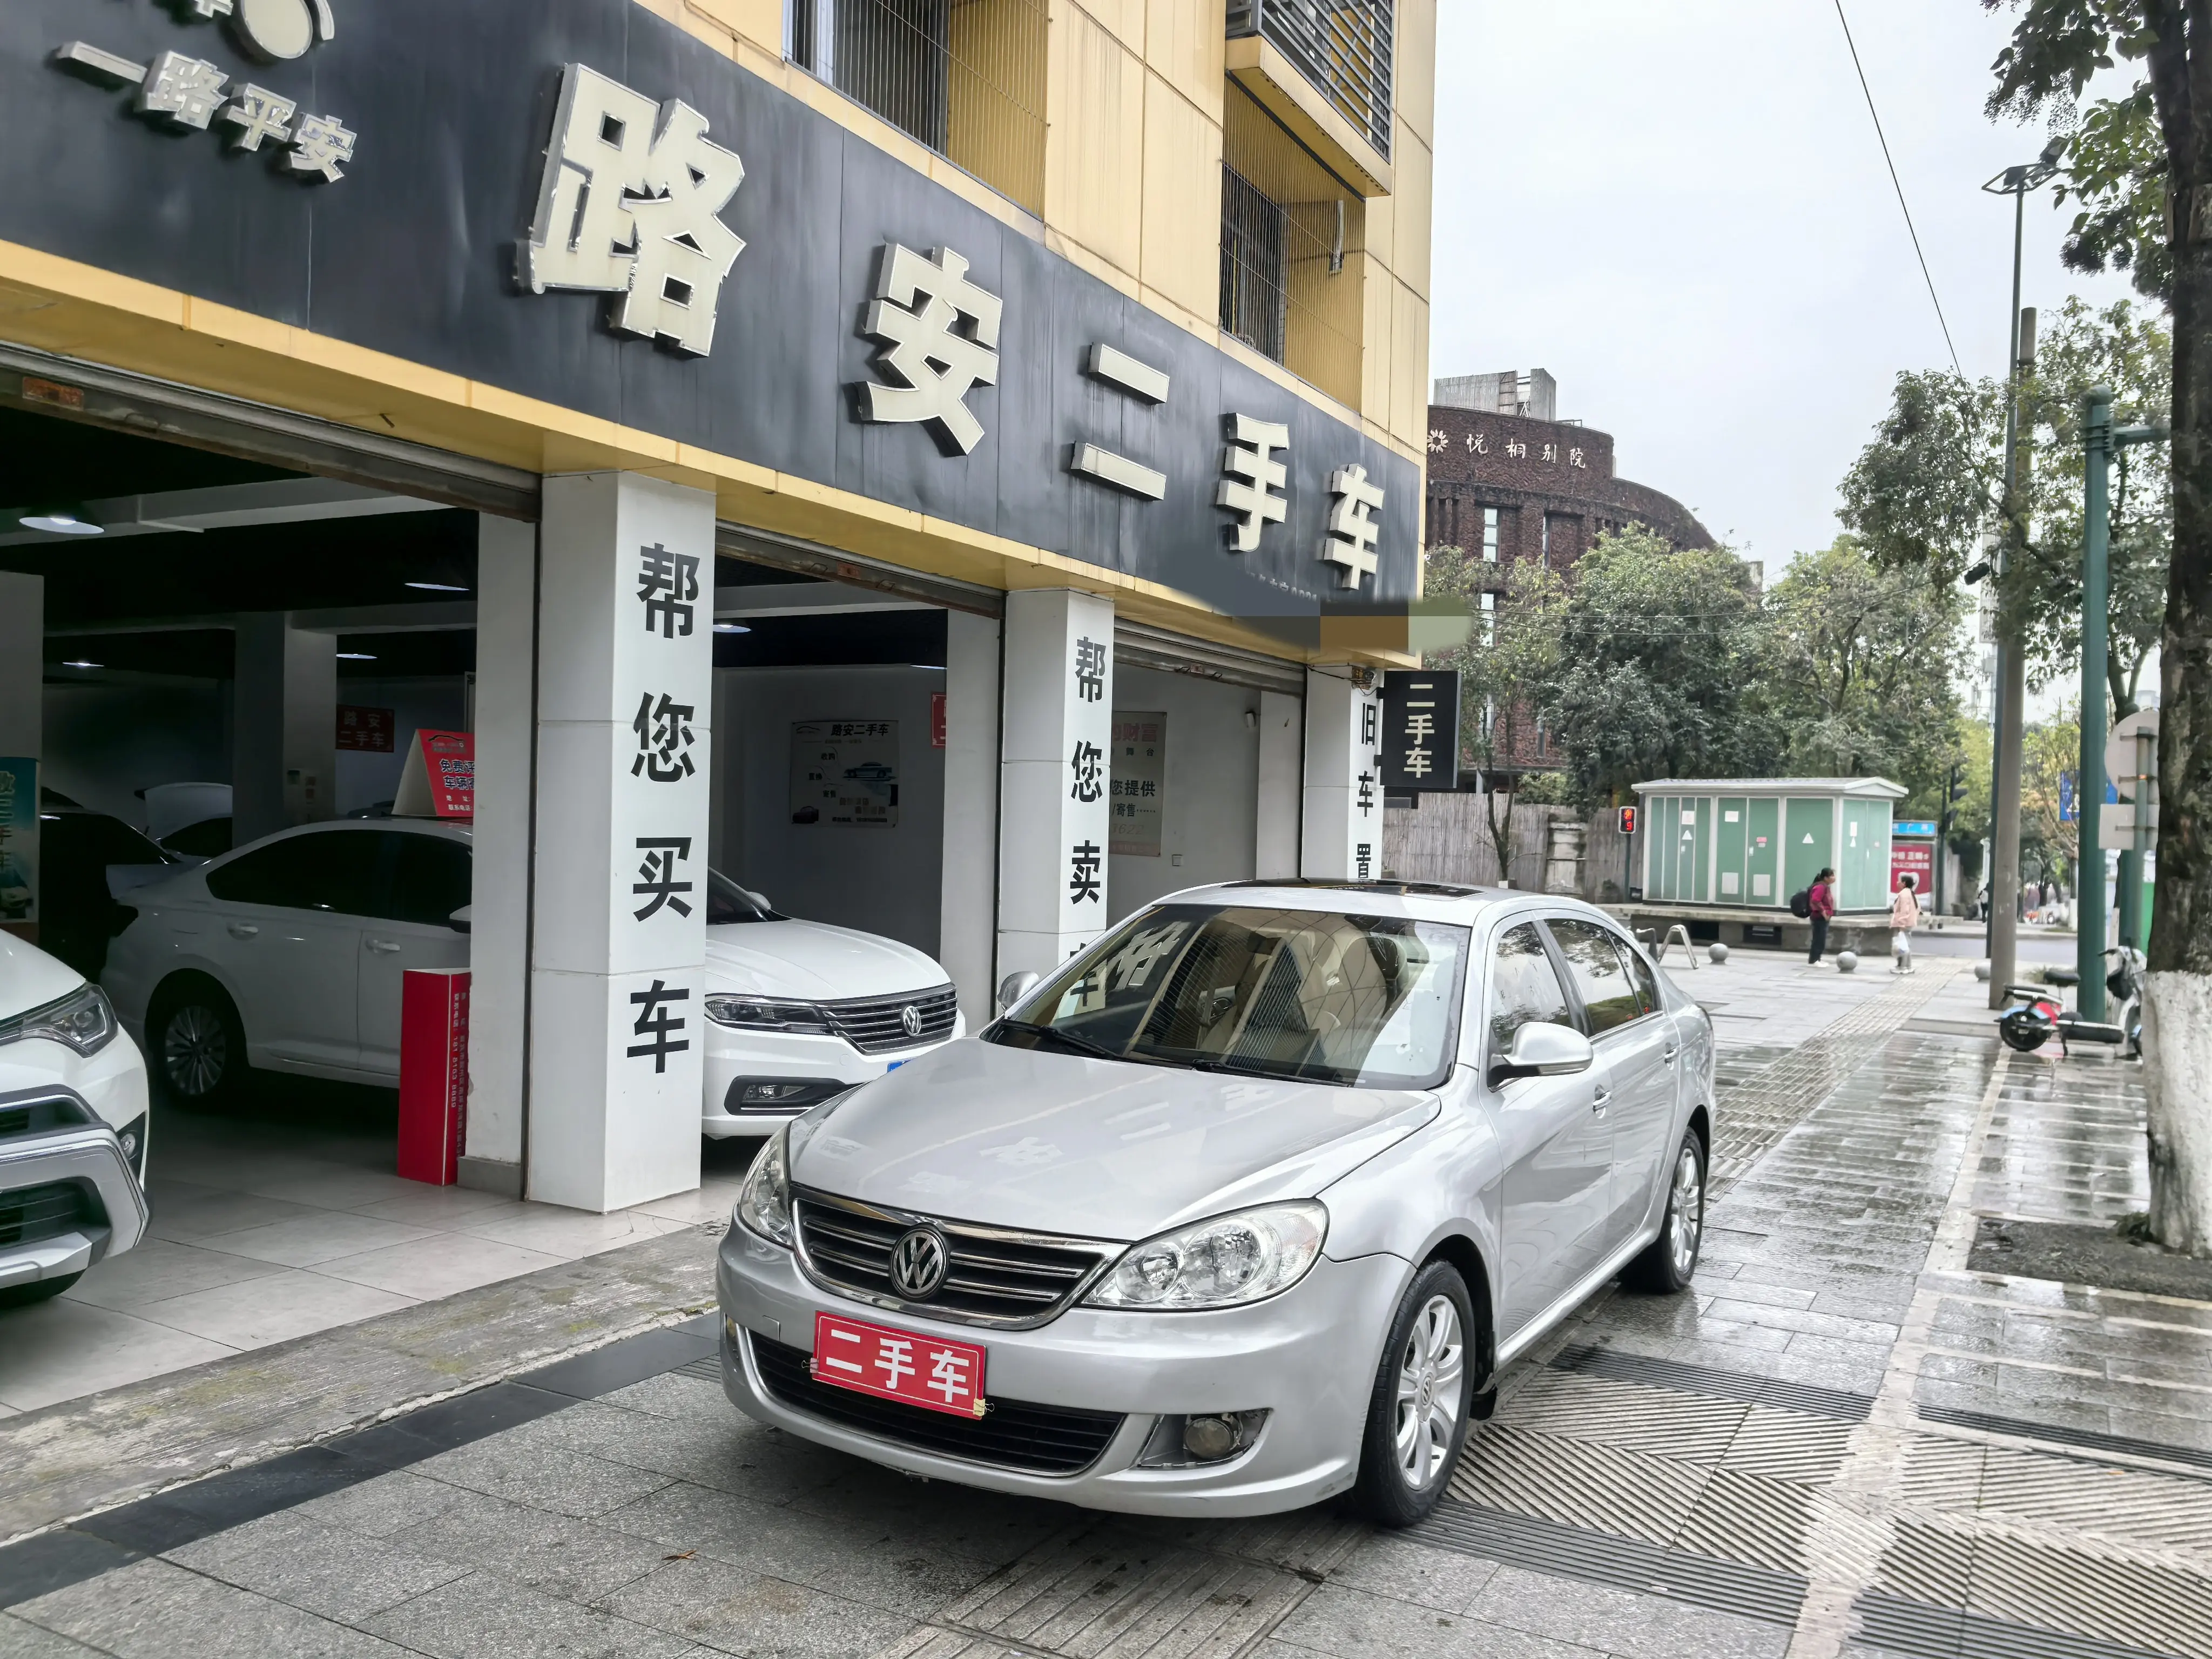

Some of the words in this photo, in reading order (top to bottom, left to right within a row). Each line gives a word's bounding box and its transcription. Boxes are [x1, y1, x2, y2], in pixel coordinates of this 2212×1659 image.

[56, 41, 357, 183] 一路平安
[515, 62, 1385, 590] 路安二手车
[1466, 433, 1586, 469] 悦桐别院
[338, 730, 386, 748] 二手车
[343, 710, 381, 729] 路安
[831, 724, 889, 736] 路安二手车
[1404, 683, 1435, 779] 二手车
[626, 542, 700, 1074] 帮您买车
[1069, 636, 1106, 961] 帮您卖
[826, 1329, 969, 1402] 二手车
